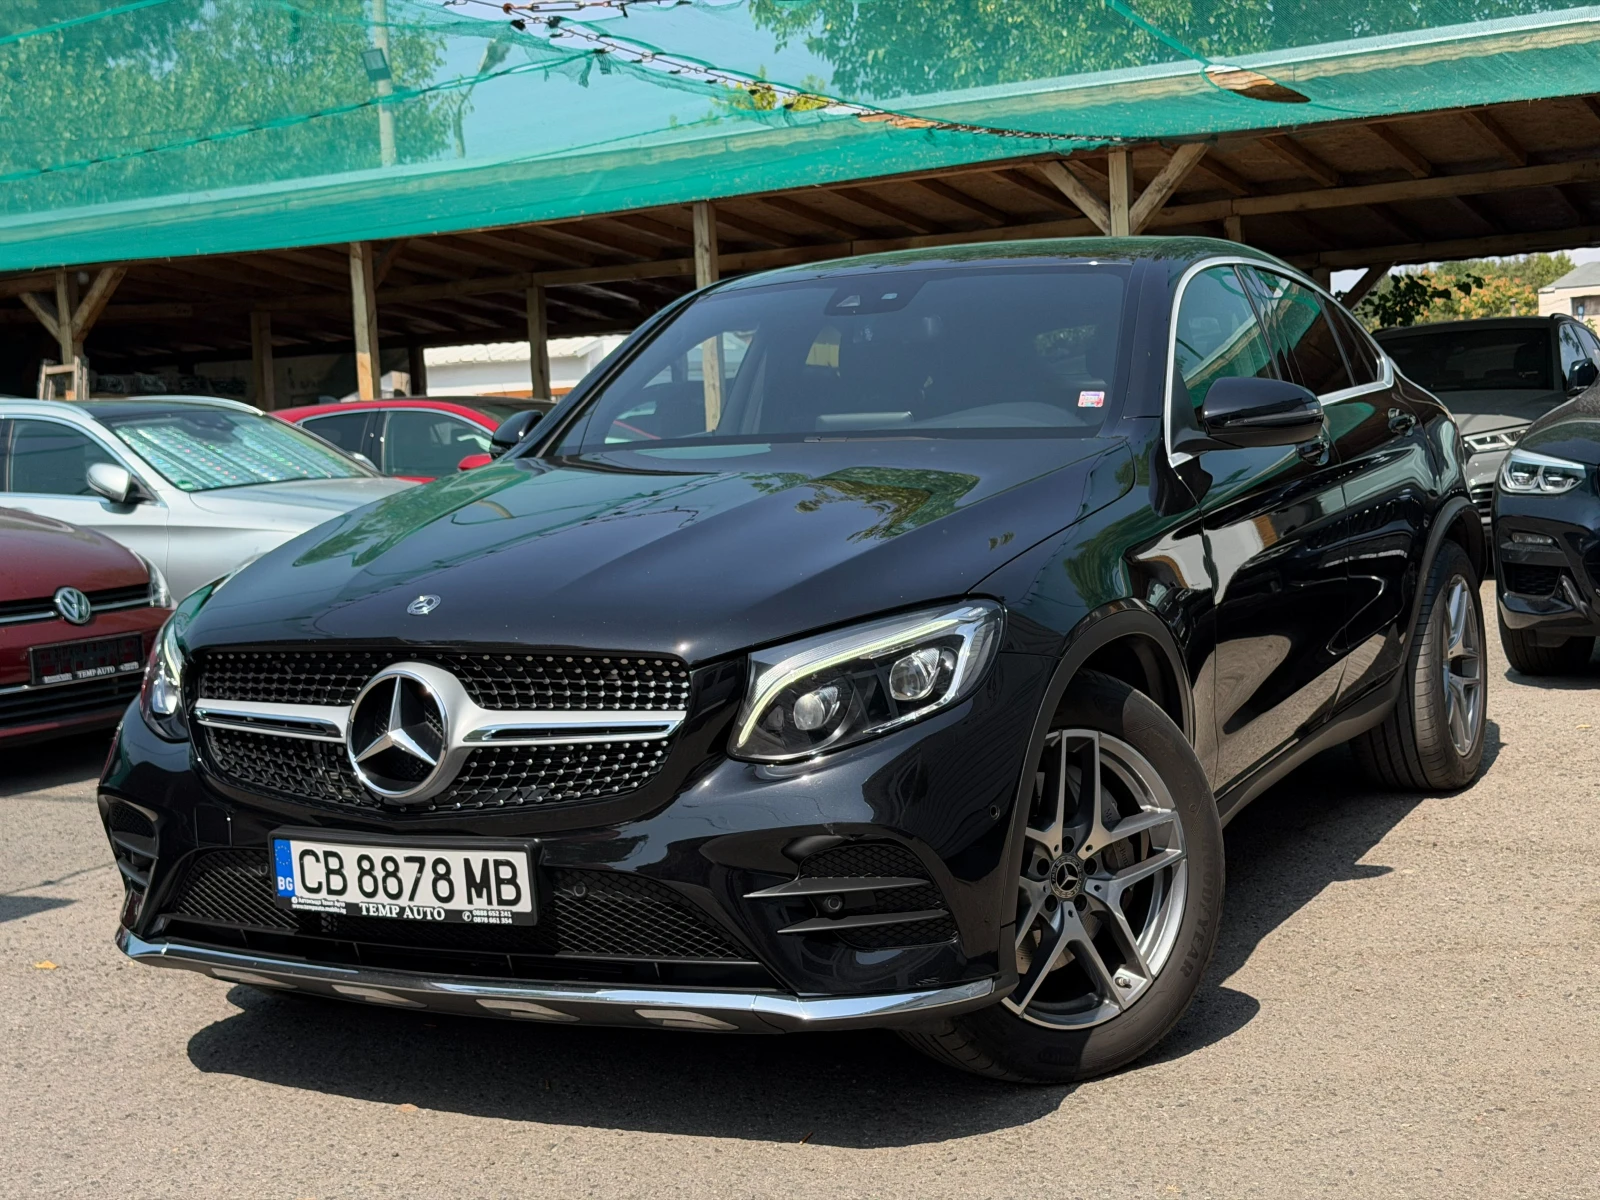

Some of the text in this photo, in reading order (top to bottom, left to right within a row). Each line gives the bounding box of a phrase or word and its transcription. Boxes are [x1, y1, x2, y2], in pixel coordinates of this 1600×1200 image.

[76, 669, 97, 678] TEMP
[97, 666, 115, 675] AUTO
[277, 876, 294, 891] BG
[356, 854, 455, 904] 8878
[463, 858, 522, 906] MB
[359, 902, 446, 921] TEMP AUTO
